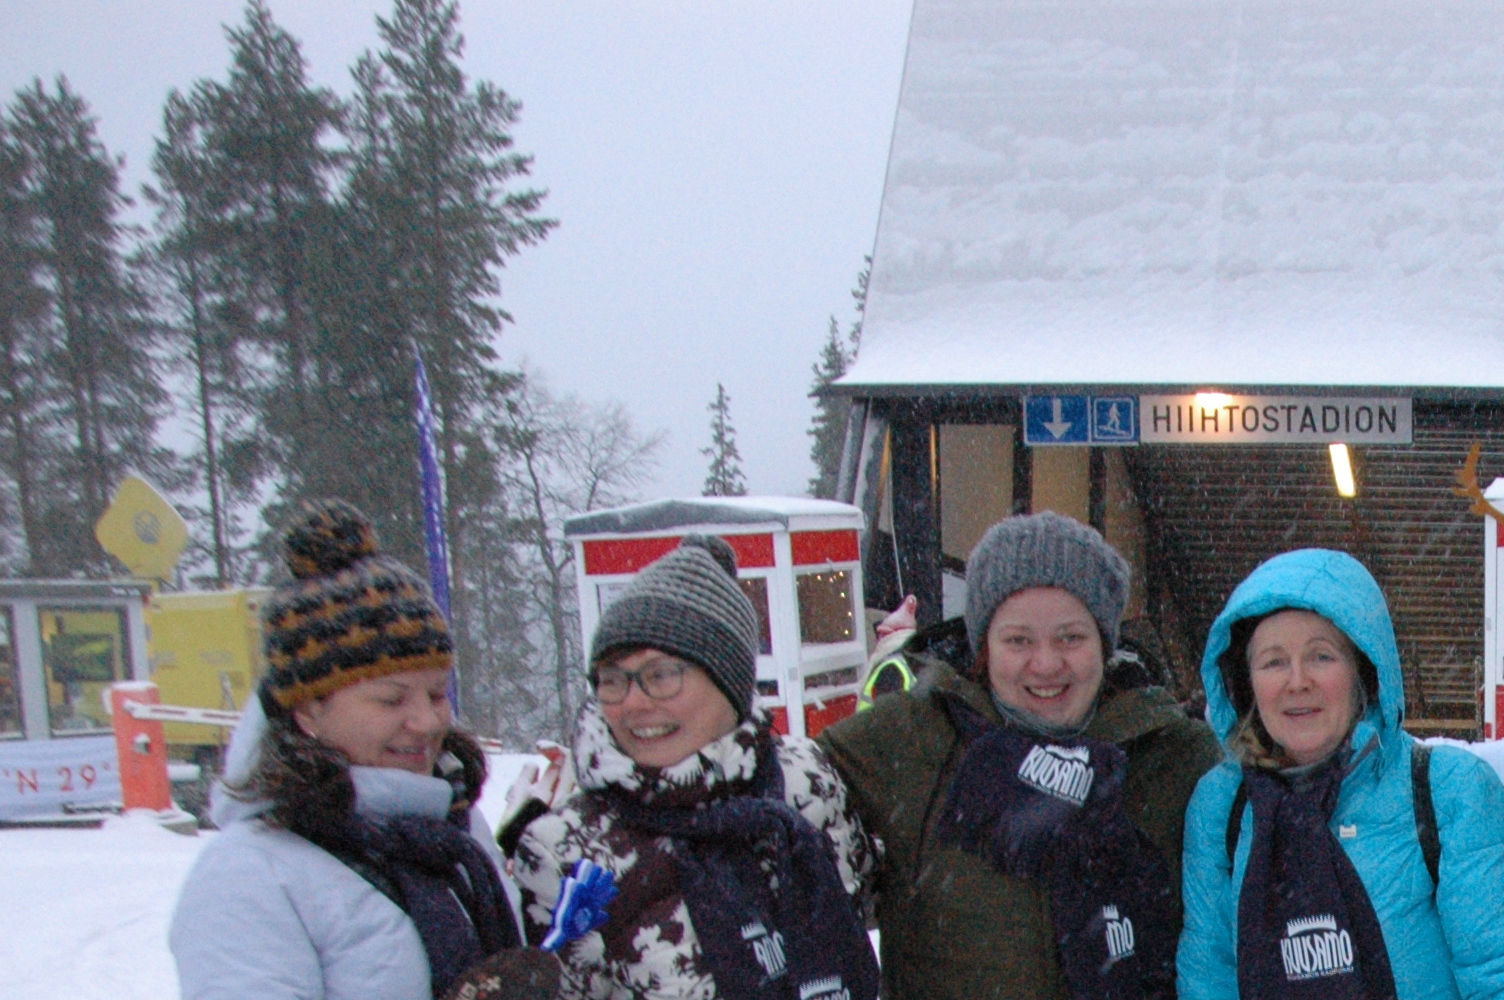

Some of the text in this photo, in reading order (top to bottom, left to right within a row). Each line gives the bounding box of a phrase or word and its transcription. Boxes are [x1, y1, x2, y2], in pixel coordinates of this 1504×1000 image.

[1151, 403, 1399, 434] HIIHTOSTADION
[1018, 744, 1094, 802] KUUSAMO
[1280, 929, 1353, 975] KUUSAMO
